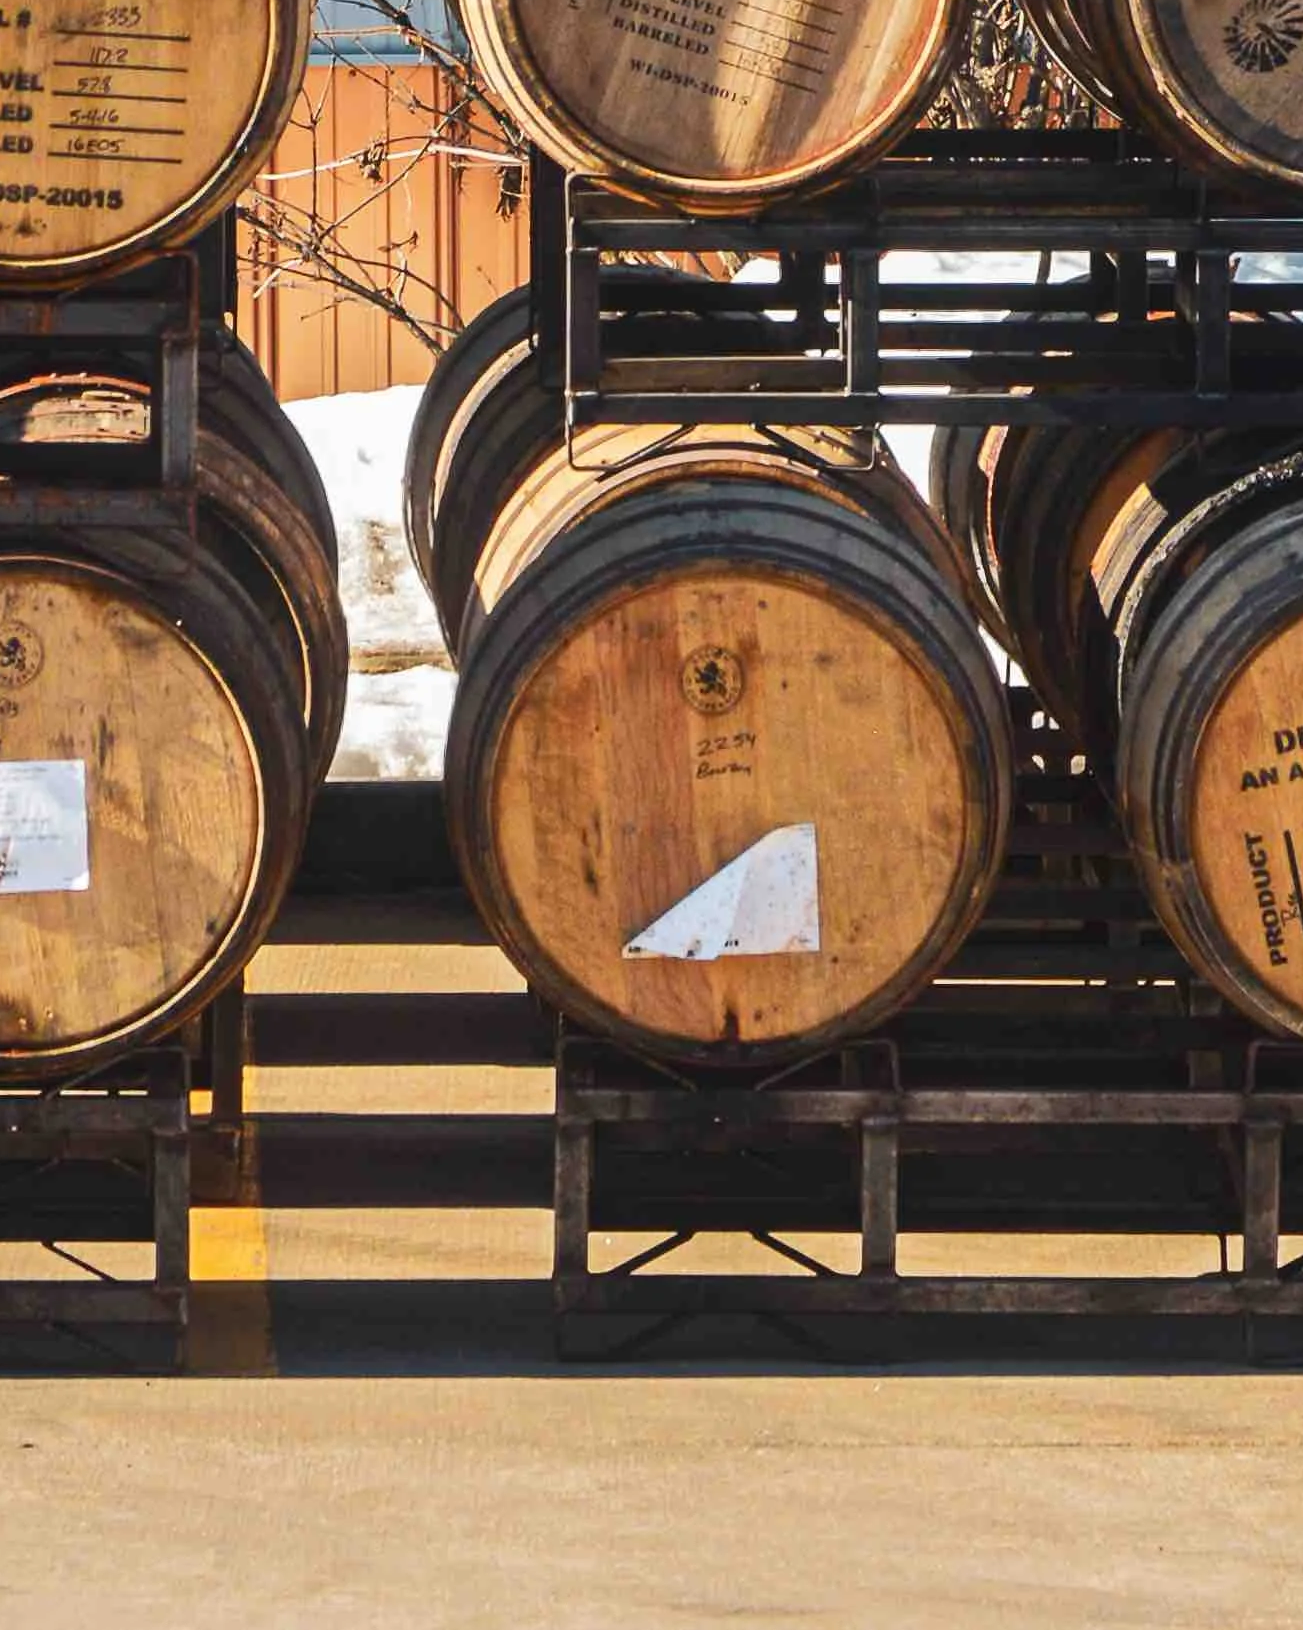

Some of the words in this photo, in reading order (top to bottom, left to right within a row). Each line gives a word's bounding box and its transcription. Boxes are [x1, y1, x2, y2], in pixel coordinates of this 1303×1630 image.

[16, 11, 31, 27] #
[613, 17, 710, 56] BARRELED
[630, 58, 749, 105] WI-DSP-20015
[1241, 768, 1279, 792] AN
[1246, 831, 1288, 967] PRODUCT
